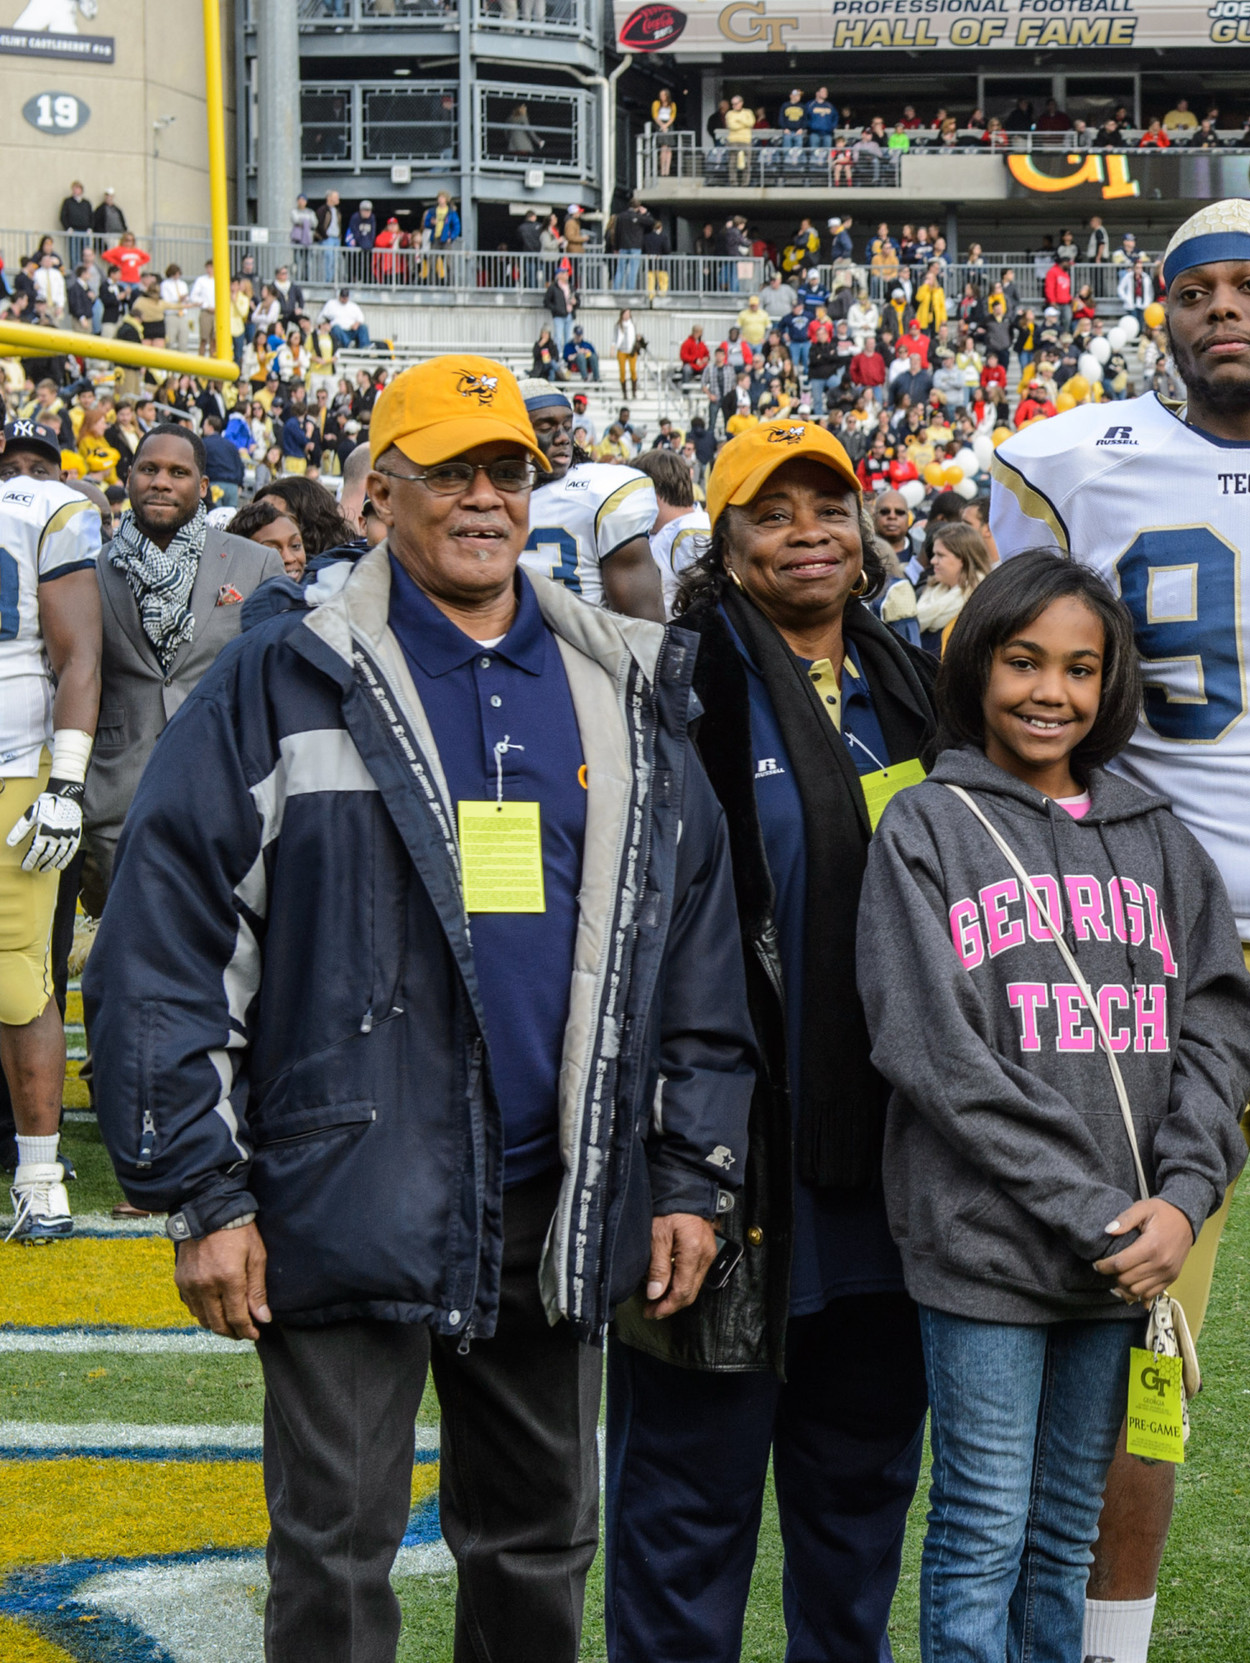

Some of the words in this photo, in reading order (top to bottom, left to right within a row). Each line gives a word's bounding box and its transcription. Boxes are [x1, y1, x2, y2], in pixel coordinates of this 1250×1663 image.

[832, 0, 1009, 14] PROFESSIONAL
[1018, 0, 1135, 12] FOOTBALL
[718, 1, 799, 52] GT
[832, 18, 939, 48] HALL
[950, 17, 1008, 47] OF
[1015, 17, 1138, 47] FAME
[37, 94, 78, 128] 19
[13, 421, 34, 437] NY
[5, 493, 32, 503] ACC
[1006, 982, 1171, 1052] TECH
[1141, 1367, 1171, 1397] GT
[1129, 1416, 1180, 1438] PRE-GAME
